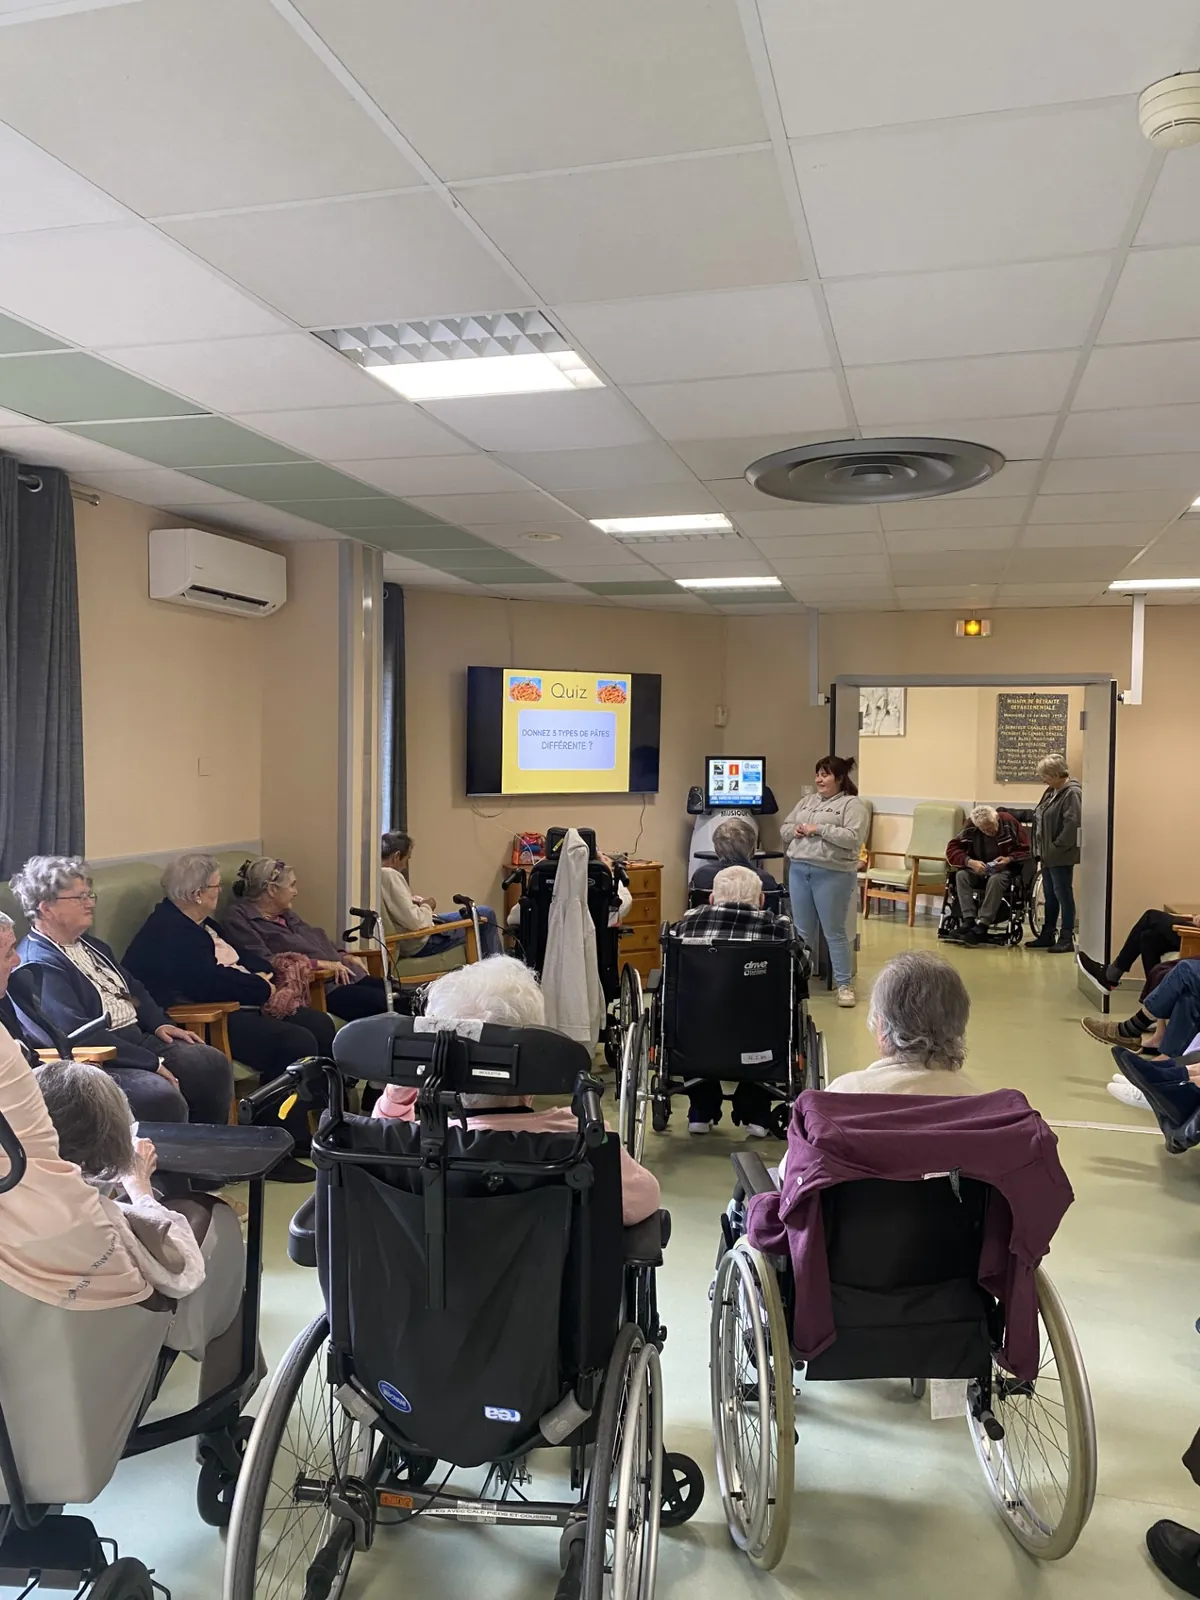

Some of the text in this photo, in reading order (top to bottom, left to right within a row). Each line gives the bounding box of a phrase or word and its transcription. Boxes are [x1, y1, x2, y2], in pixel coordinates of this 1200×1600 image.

[550, 682, 588, 700] Quiz
[521, 728, 551, 737] DONNEZ
[558, 729, 579, 737] TYPES
[579, 729, 589, 737] DE
[590, 728, 610, 738] PÂTES
[541, 739, 594, 750] DIFFÉRENTE ?
[743, 960, 768, 969] drive
